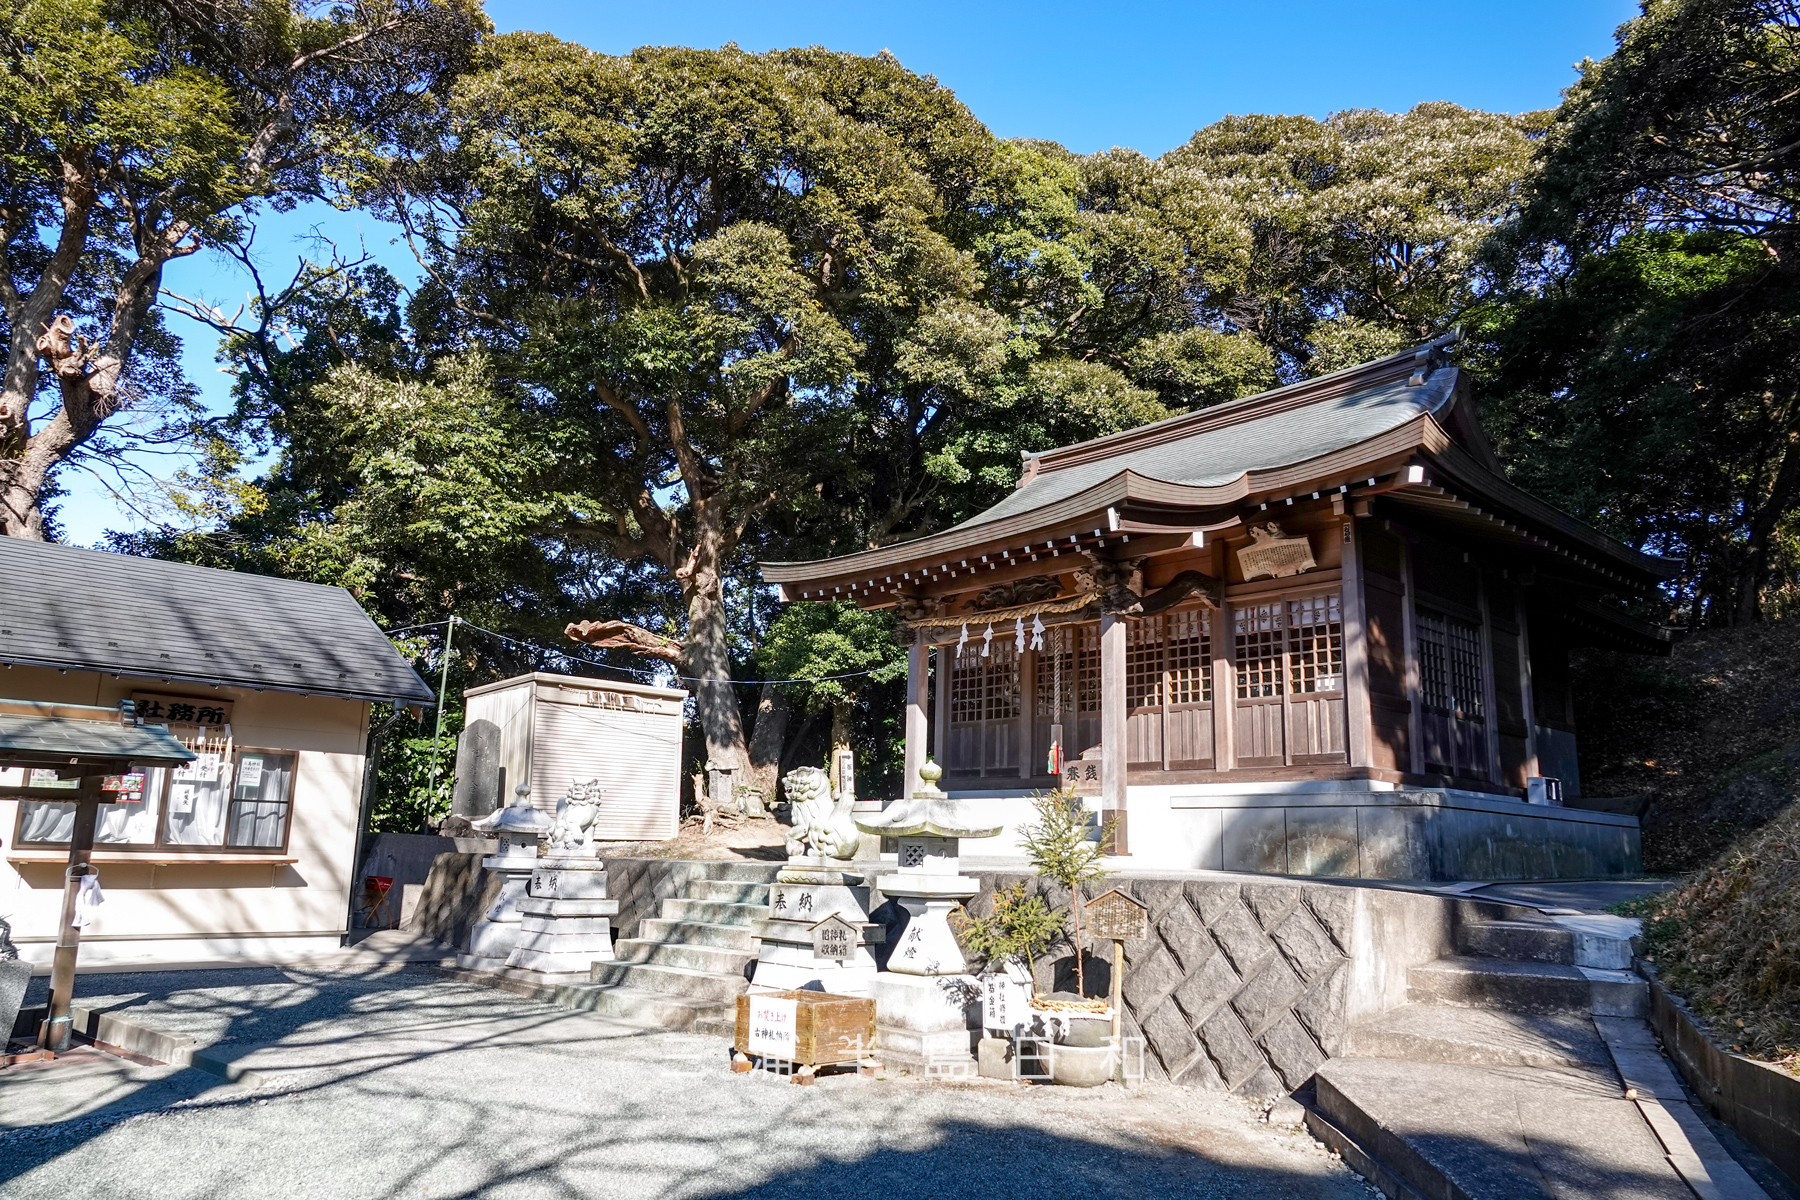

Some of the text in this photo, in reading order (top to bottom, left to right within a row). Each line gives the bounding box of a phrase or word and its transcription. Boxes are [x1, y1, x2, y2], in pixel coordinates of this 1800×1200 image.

[136, 700, 226, 724] 社務所
[534, 876, 558, 892] 奉納
[775, 890, 813, 912] 奉納
[821, 943, 847, 957] 収納箱
